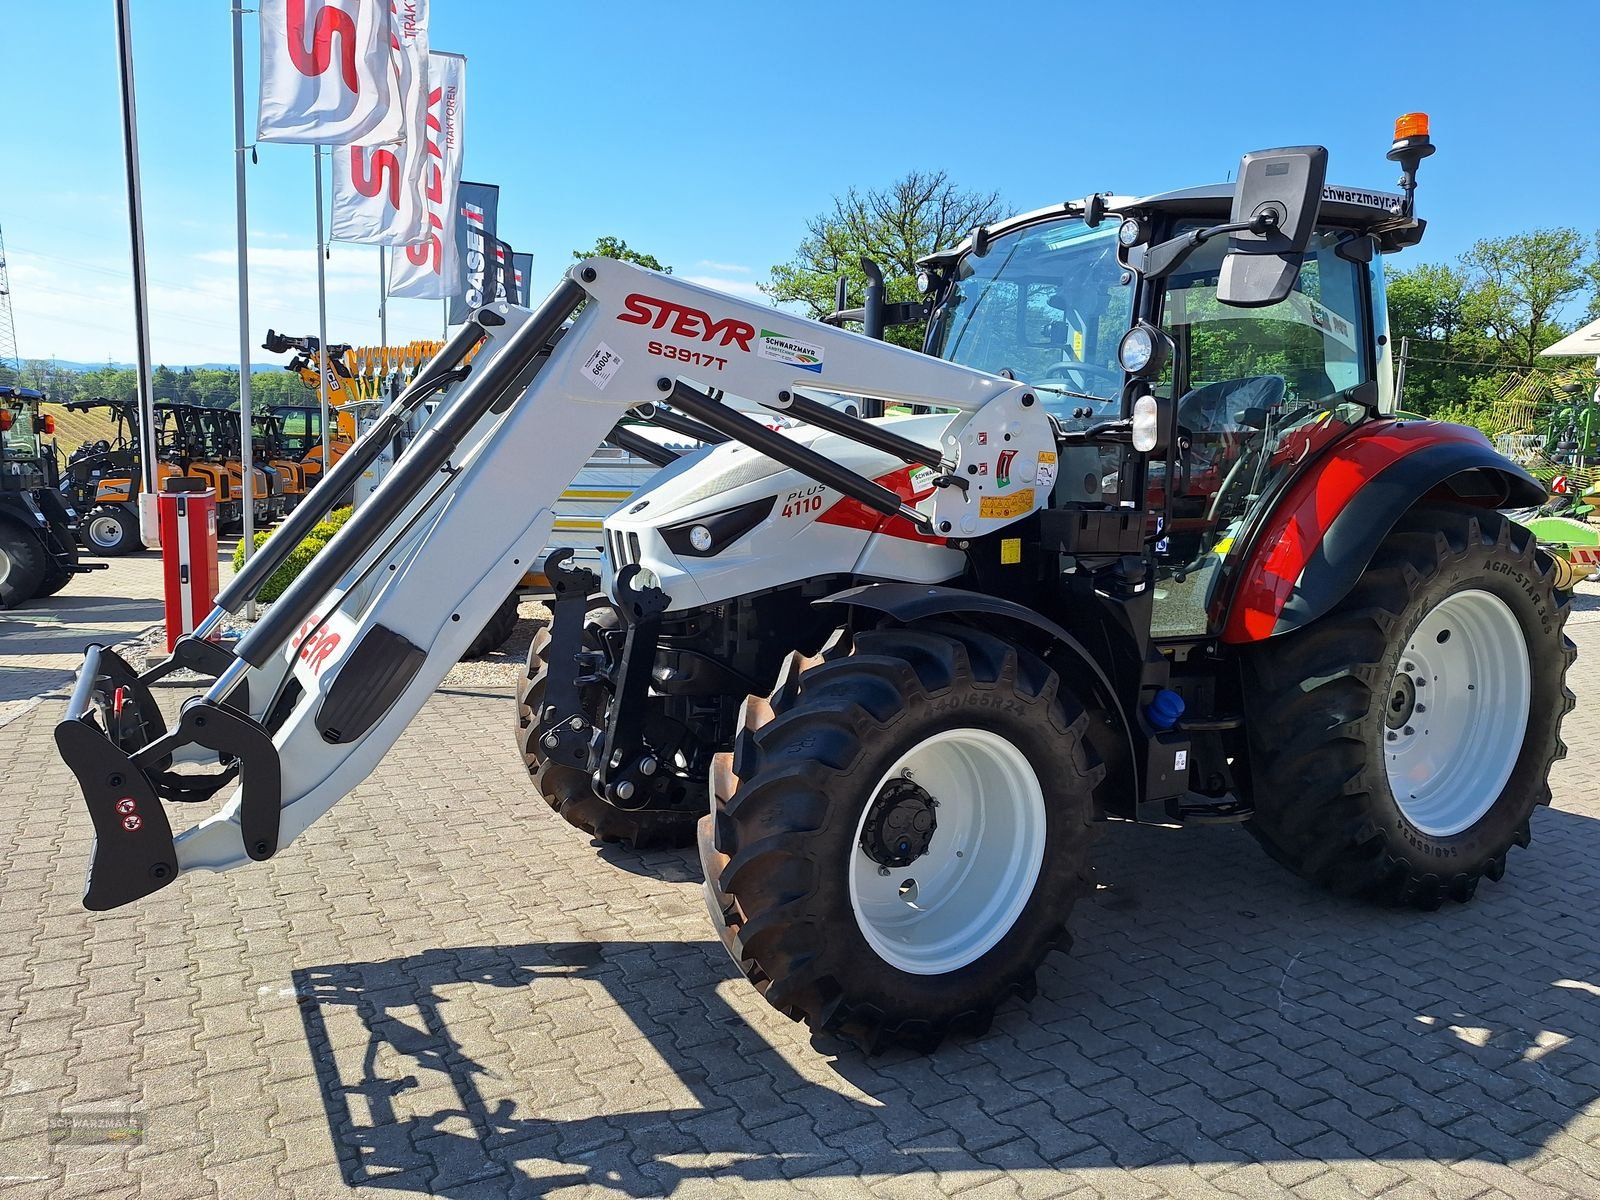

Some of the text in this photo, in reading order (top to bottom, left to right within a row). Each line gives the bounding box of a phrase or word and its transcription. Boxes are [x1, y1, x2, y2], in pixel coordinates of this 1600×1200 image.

[445, 85, 456, 150] TRAKTOREN
[465, 230, 486, 309] CASE
[616, 293, 755, 352] STEYR
[647, 341, 728, 371] S3917T
[765, 337, 816, 356] SCHWARZMAYR
[592, 351, 612, 376] 66004
[326, 368, 341, 391] CB
[787, 483, 826, 502] PLUS
[781, 495, 823, 518] 4110
